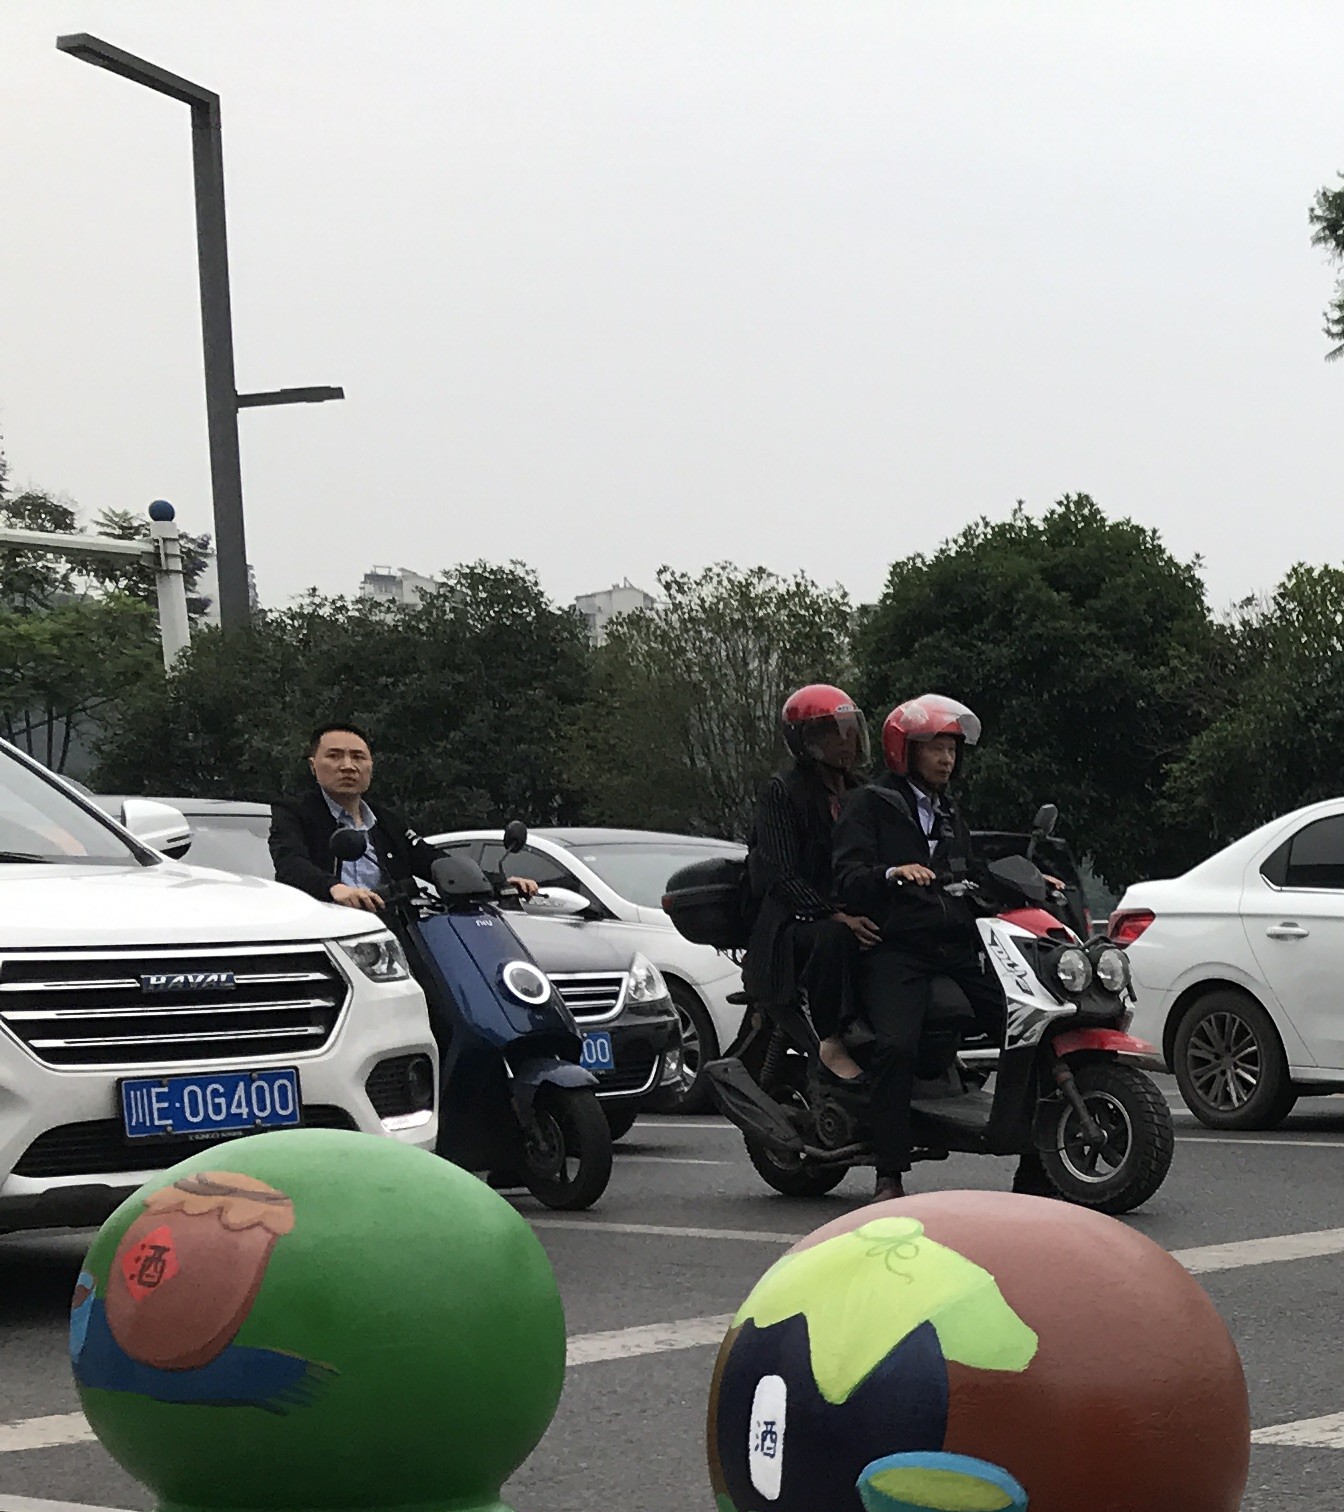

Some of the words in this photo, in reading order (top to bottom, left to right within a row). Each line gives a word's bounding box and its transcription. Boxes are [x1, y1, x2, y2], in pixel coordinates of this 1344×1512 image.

[148, 973, 236, 991] HAVAL
[129, 1244, 171, 1289] 酒
[755, 1420, 778, 1459] 酒
